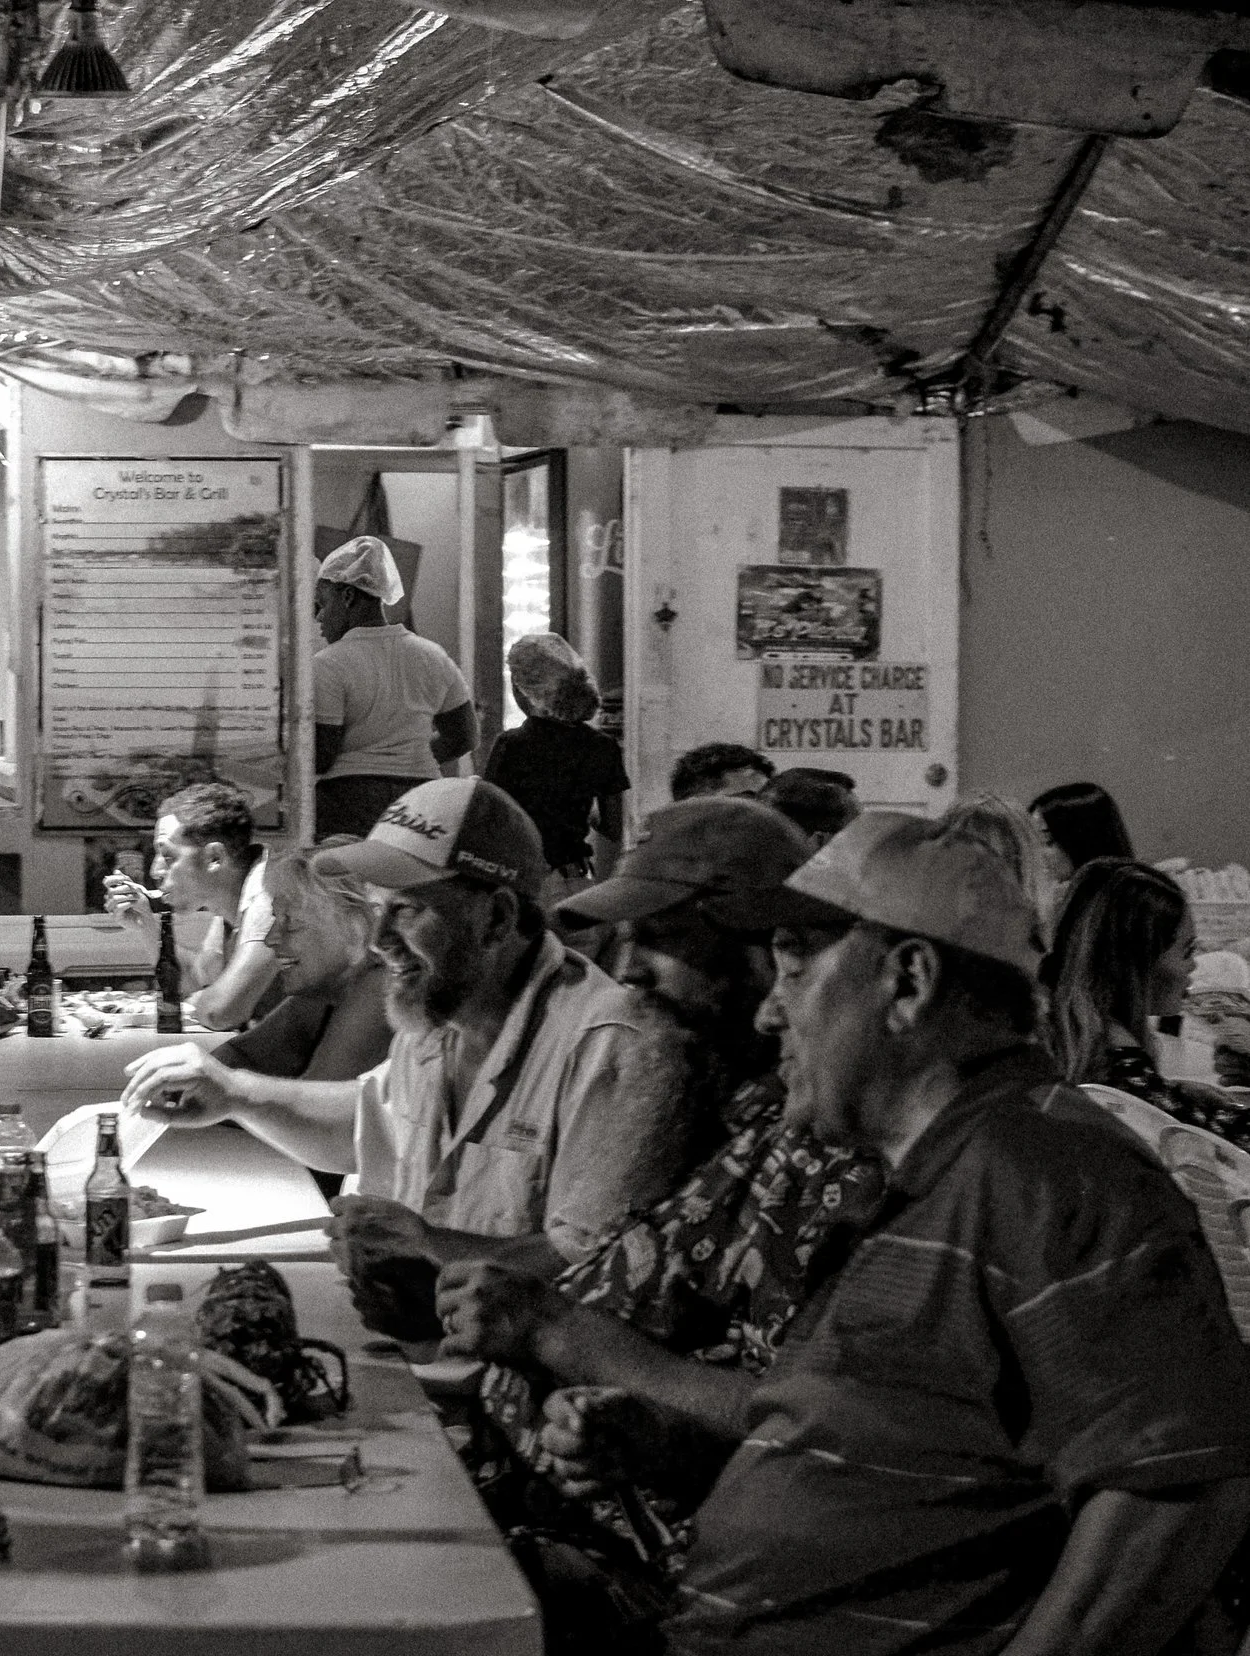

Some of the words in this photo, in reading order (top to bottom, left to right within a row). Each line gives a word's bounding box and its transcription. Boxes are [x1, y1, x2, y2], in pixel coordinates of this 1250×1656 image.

[118, 470, 185, 483] Welcome
[188, 471, 204, 483] to
[93, 486, 151, 502] Crystal's
[154, 486, 180, 500] Bar
[184, 486, 196, 500] &
[199, 486, 230, 500] Grill
[762, 664, 784, 689] NO
[788, 664, 855, 690] SERVICE
[861, 665, 925, 690] CHARGE
[828, 693, 859, 715] AT
[765, 718, 873, 748] CRYSTALS
[880, 718, 925, 748] BAR
